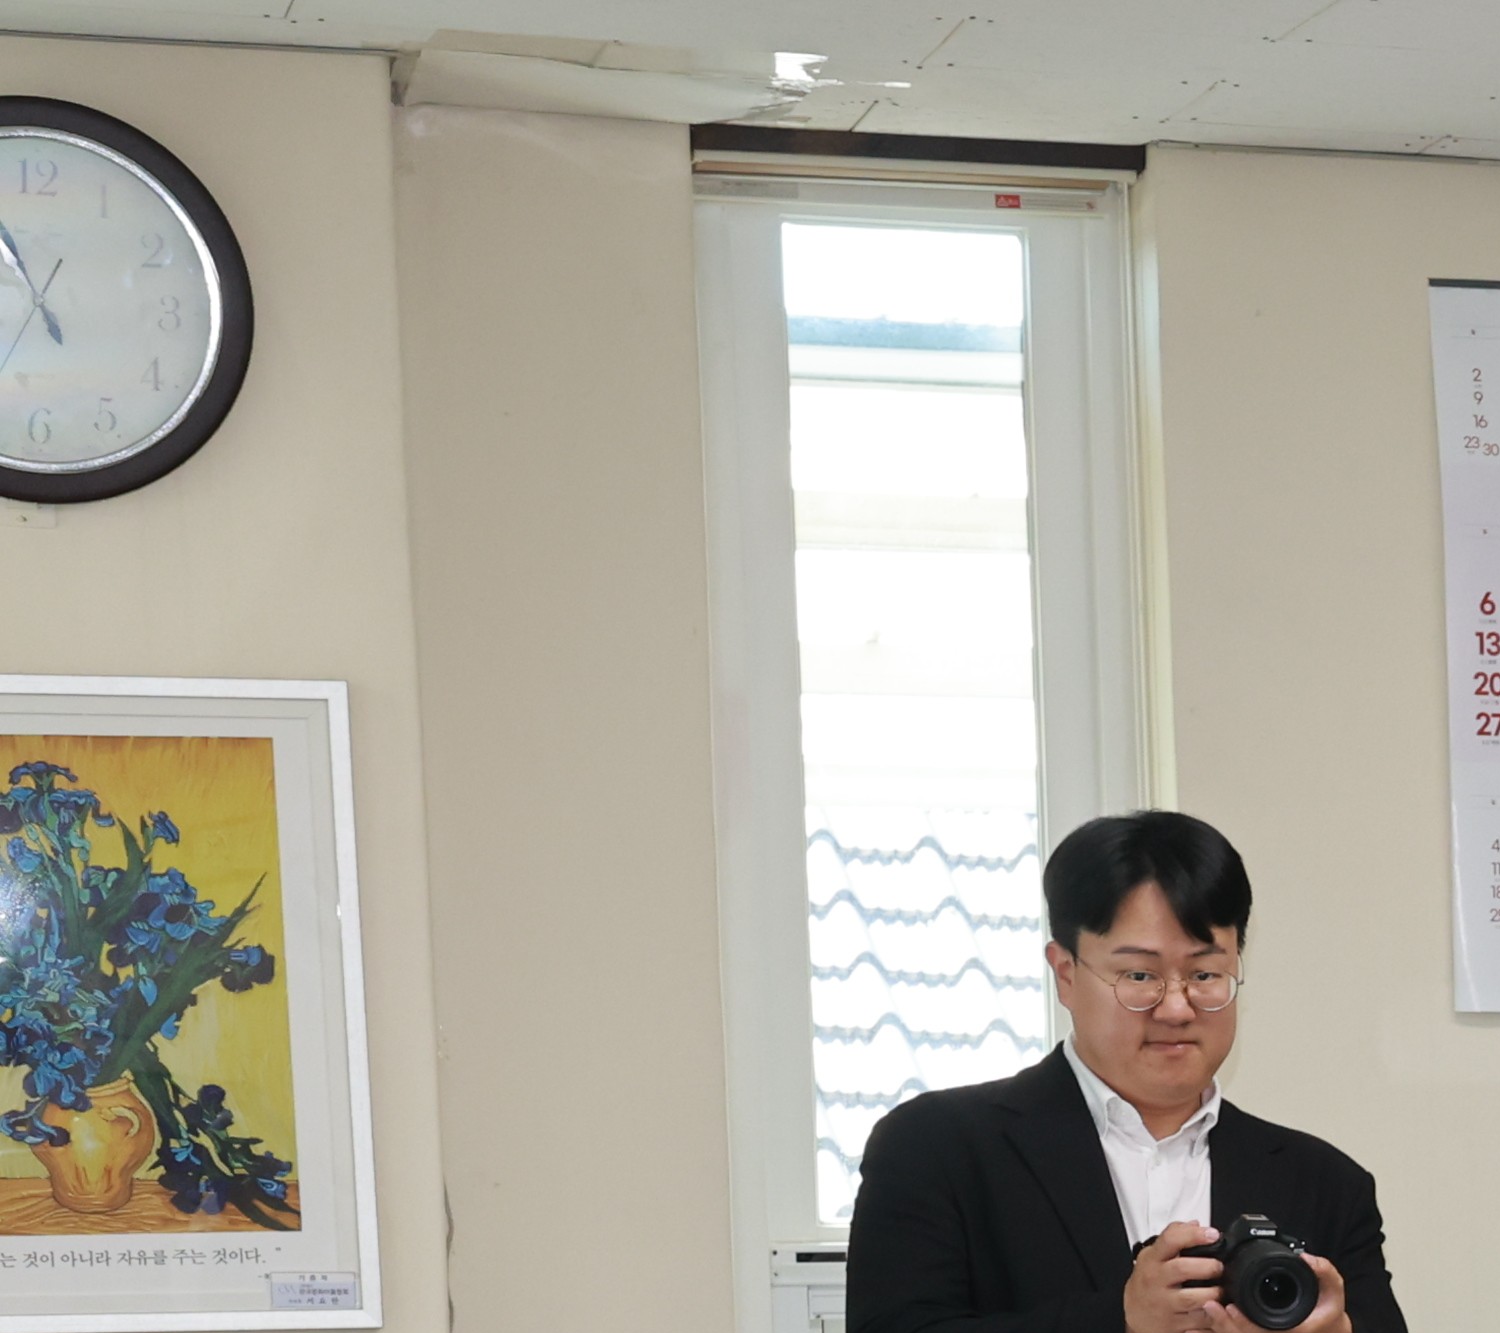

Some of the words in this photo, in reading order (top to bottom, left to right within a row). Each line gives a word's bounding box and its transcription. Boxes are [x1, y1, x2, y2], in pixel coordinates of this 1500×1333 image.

[16, 160, 58, 197] 12
[96, 186, 111, 218] 1
[141, 236, 165, 269] 2
[157, 297, 181, 332] 3
[141, 359, 165, 392] 4
[28, 410, 52, 444] 6
[93, 398, 117, 432] 5
[1479, 591, 1495, 615] 6
[1475, 631, 1500, 656] 13
[23, 1252, 55, 1268] 것이
[61, 1251, 111, 1267] 아니라
[116, 1249, 168, 1266] 자유를
[172, 1248, 207, 1265] 주는
